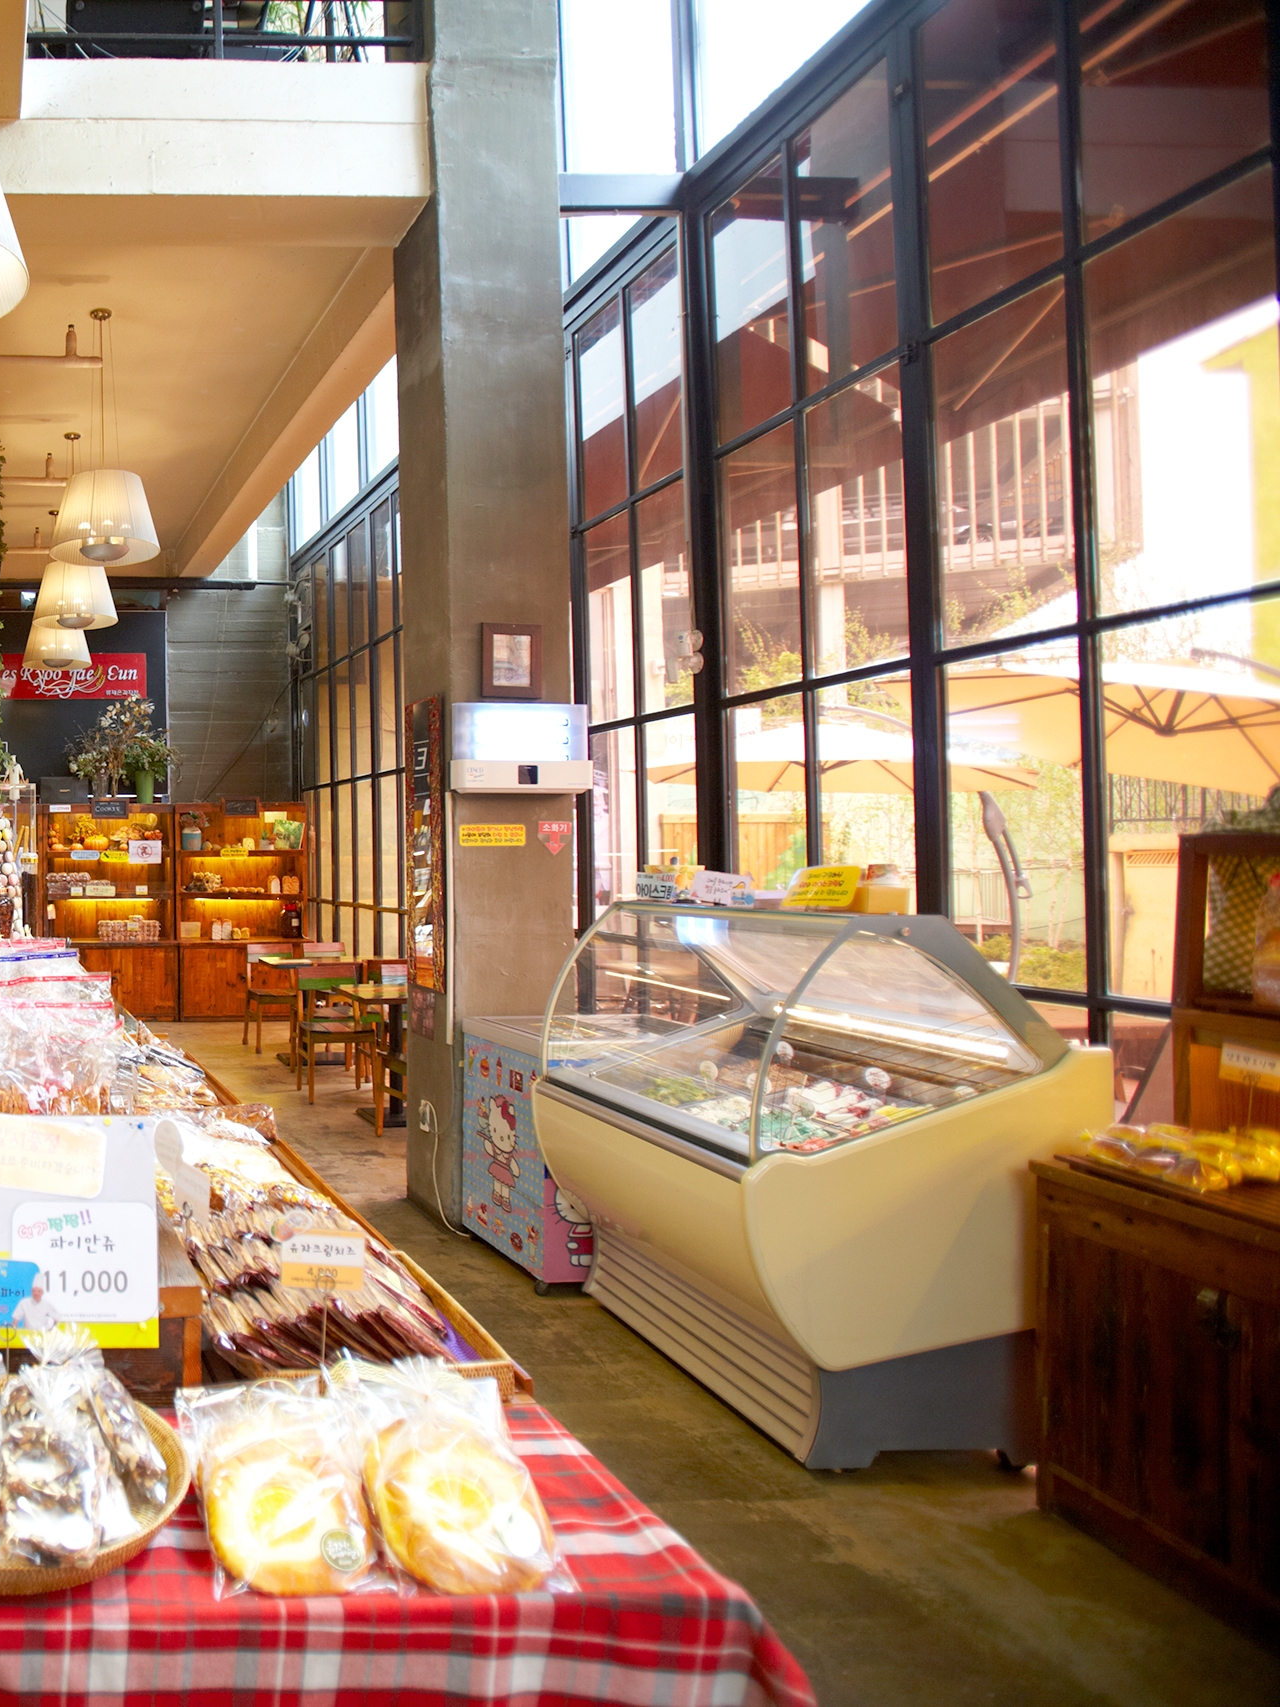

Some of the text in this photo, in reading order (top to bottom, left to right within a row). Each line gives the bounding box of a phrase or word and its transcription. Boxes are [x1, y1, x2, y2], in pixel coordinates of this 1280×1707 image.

[107, 665, 138, 681] Eun
[542, 823, 567, 832] 소화기
[637, 883, 673, 900] 아이스크림
[50, 1235, 115, 1253] 파이만쥬
[290, 1244, 356, 1257] 유자크림치즈
[307, 1267, 338, 1278] 4,800
[44, 1270, 128, 1296] 11,000
